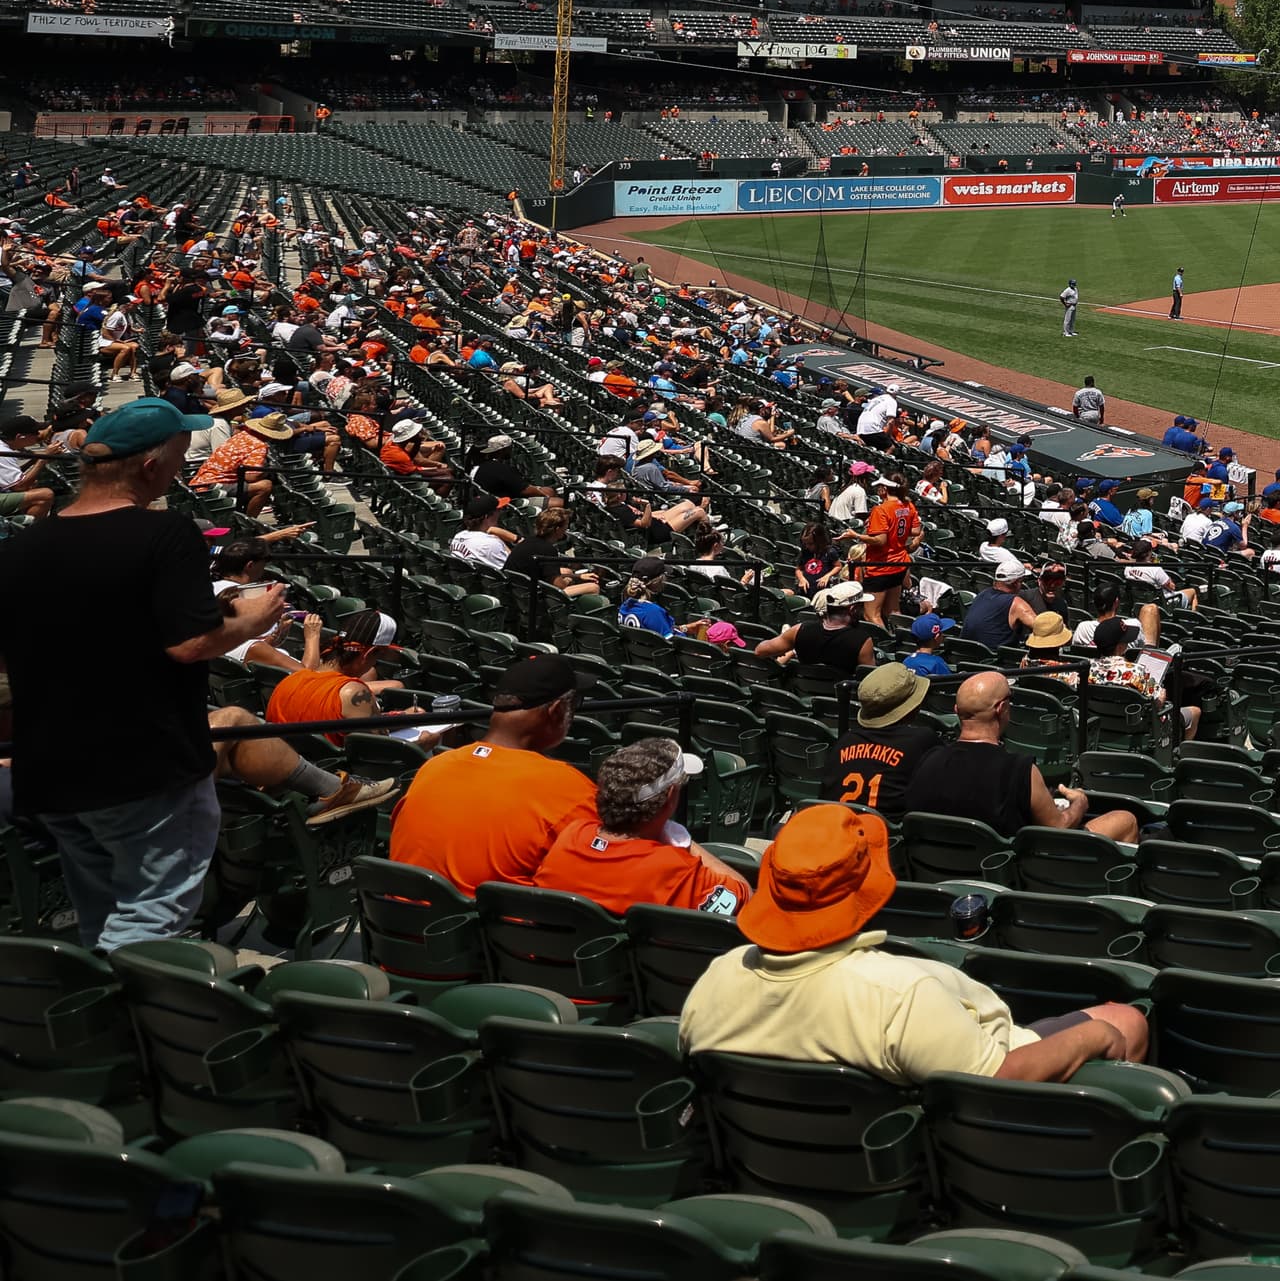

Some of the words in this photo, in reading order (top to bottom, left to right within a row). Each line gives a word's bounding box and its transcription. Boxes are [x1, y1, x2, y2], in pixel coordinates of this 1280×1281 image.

[32, 15, 57, 25] THIZ
[60, 17, 72, 25] IZ
[74, 17, 101, 26] FOWL
[970, 47, 1011, 59] UNION
[1086, 53, 1118, 61] JOHNSON
[1212, 158, 1242, 167] BIRD
[1244, 157, 1275, 167] BATH
[627, 185, 667, 195] Point
[671, 185, 722, 195] Breeze
[870, 185, 885, 193] ERIE
[916, 184, 927, 192] OF
[953, 182, 993, 196] weis
[996, 181, 1066, 195] markets
[1172, 181, 1220, 195] Airtemp
[850, 192, 899, 200] OSTEOPATHIC
[532, 199, 546, 208] 333
[686, 204, 717, 212] Banking
[840, 743, 904, 767] MARKAKIS
[839, 772, 883, 808] 21
